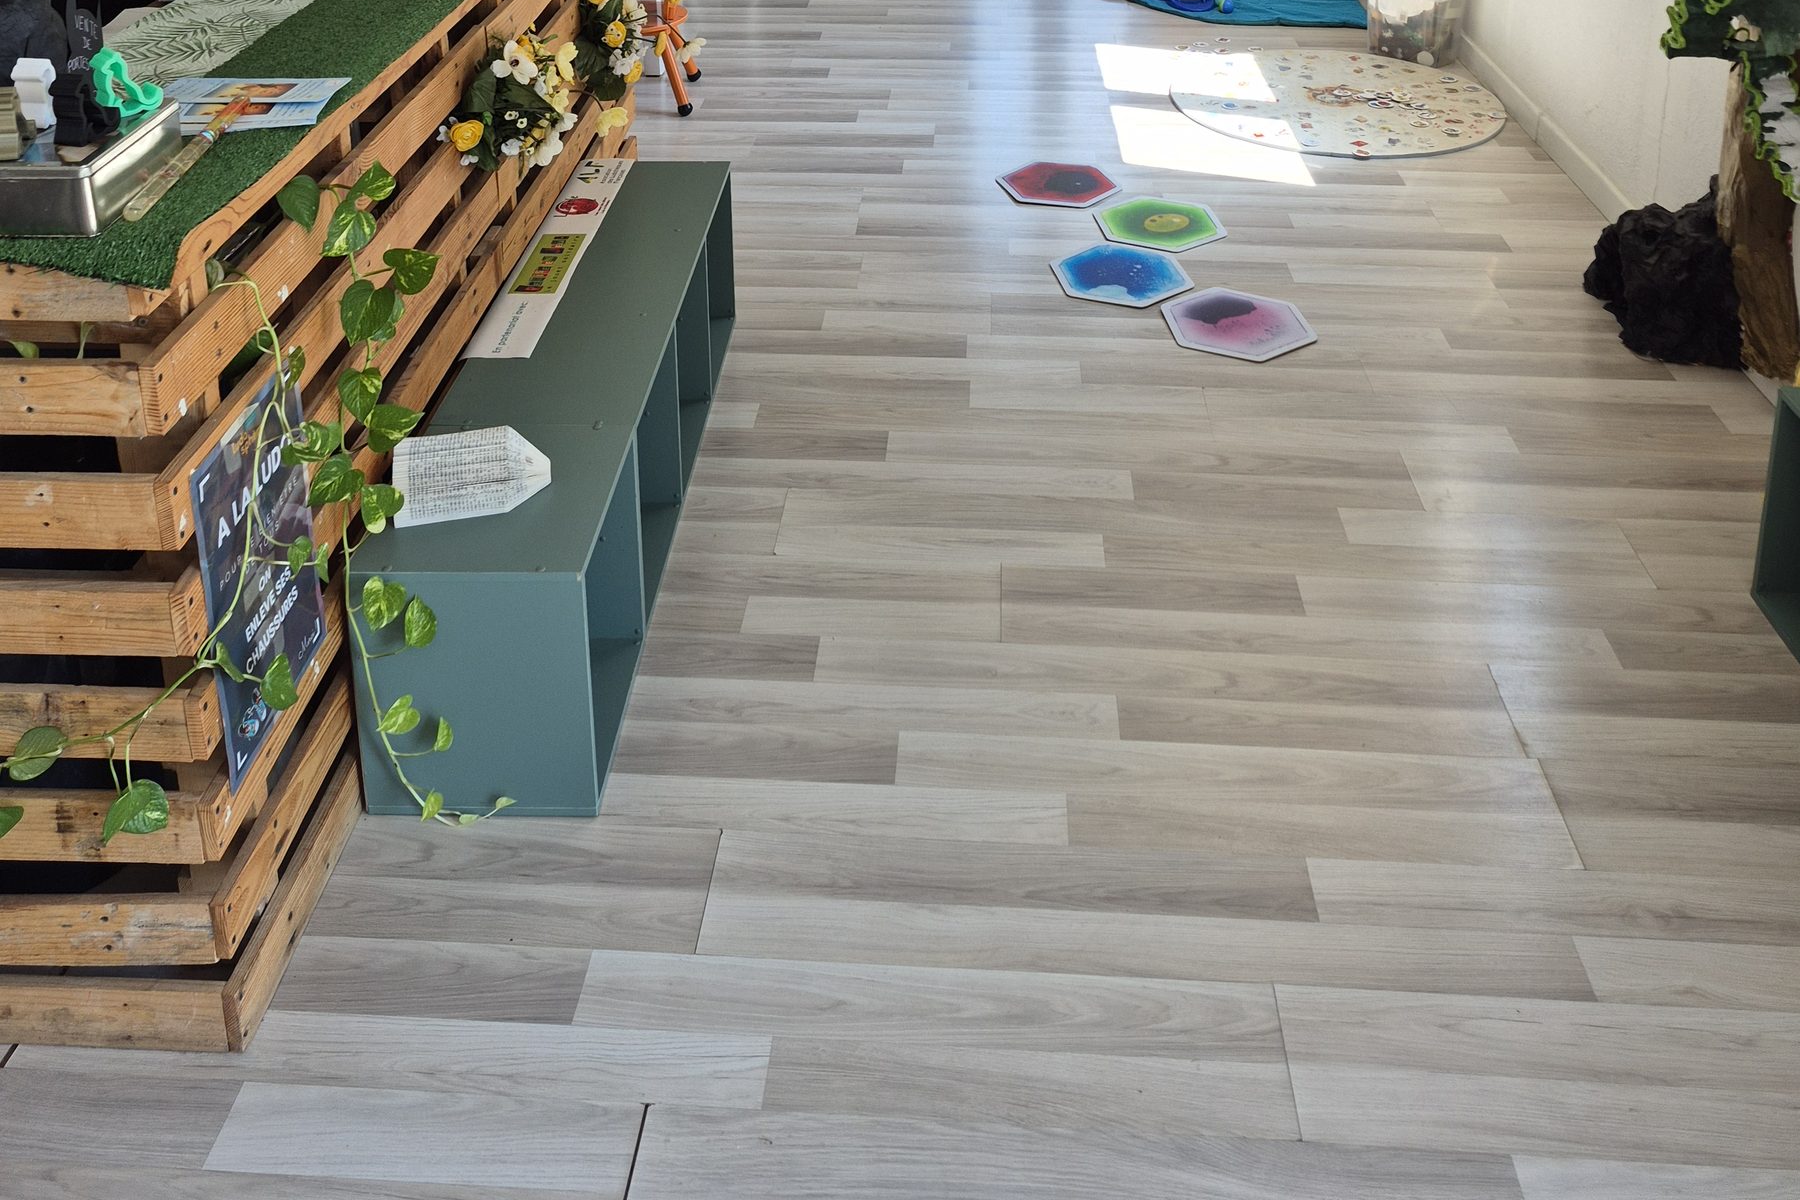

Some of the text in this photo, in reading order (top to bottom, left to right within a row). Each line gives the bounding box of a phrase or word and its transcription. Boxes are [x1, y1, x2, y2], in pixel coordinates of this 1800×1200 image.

[498, 315, 519, 346] partenariat
[217, 516, 232, 549] A
[231, 485, 251, 527] LA
[218, 555, 242, 593] POUR
[257, 564, 273, 593] ON
[244, 564, 293, 644] ENLEVE SES
[245, 583, 300, 675] CHAUSSURES
